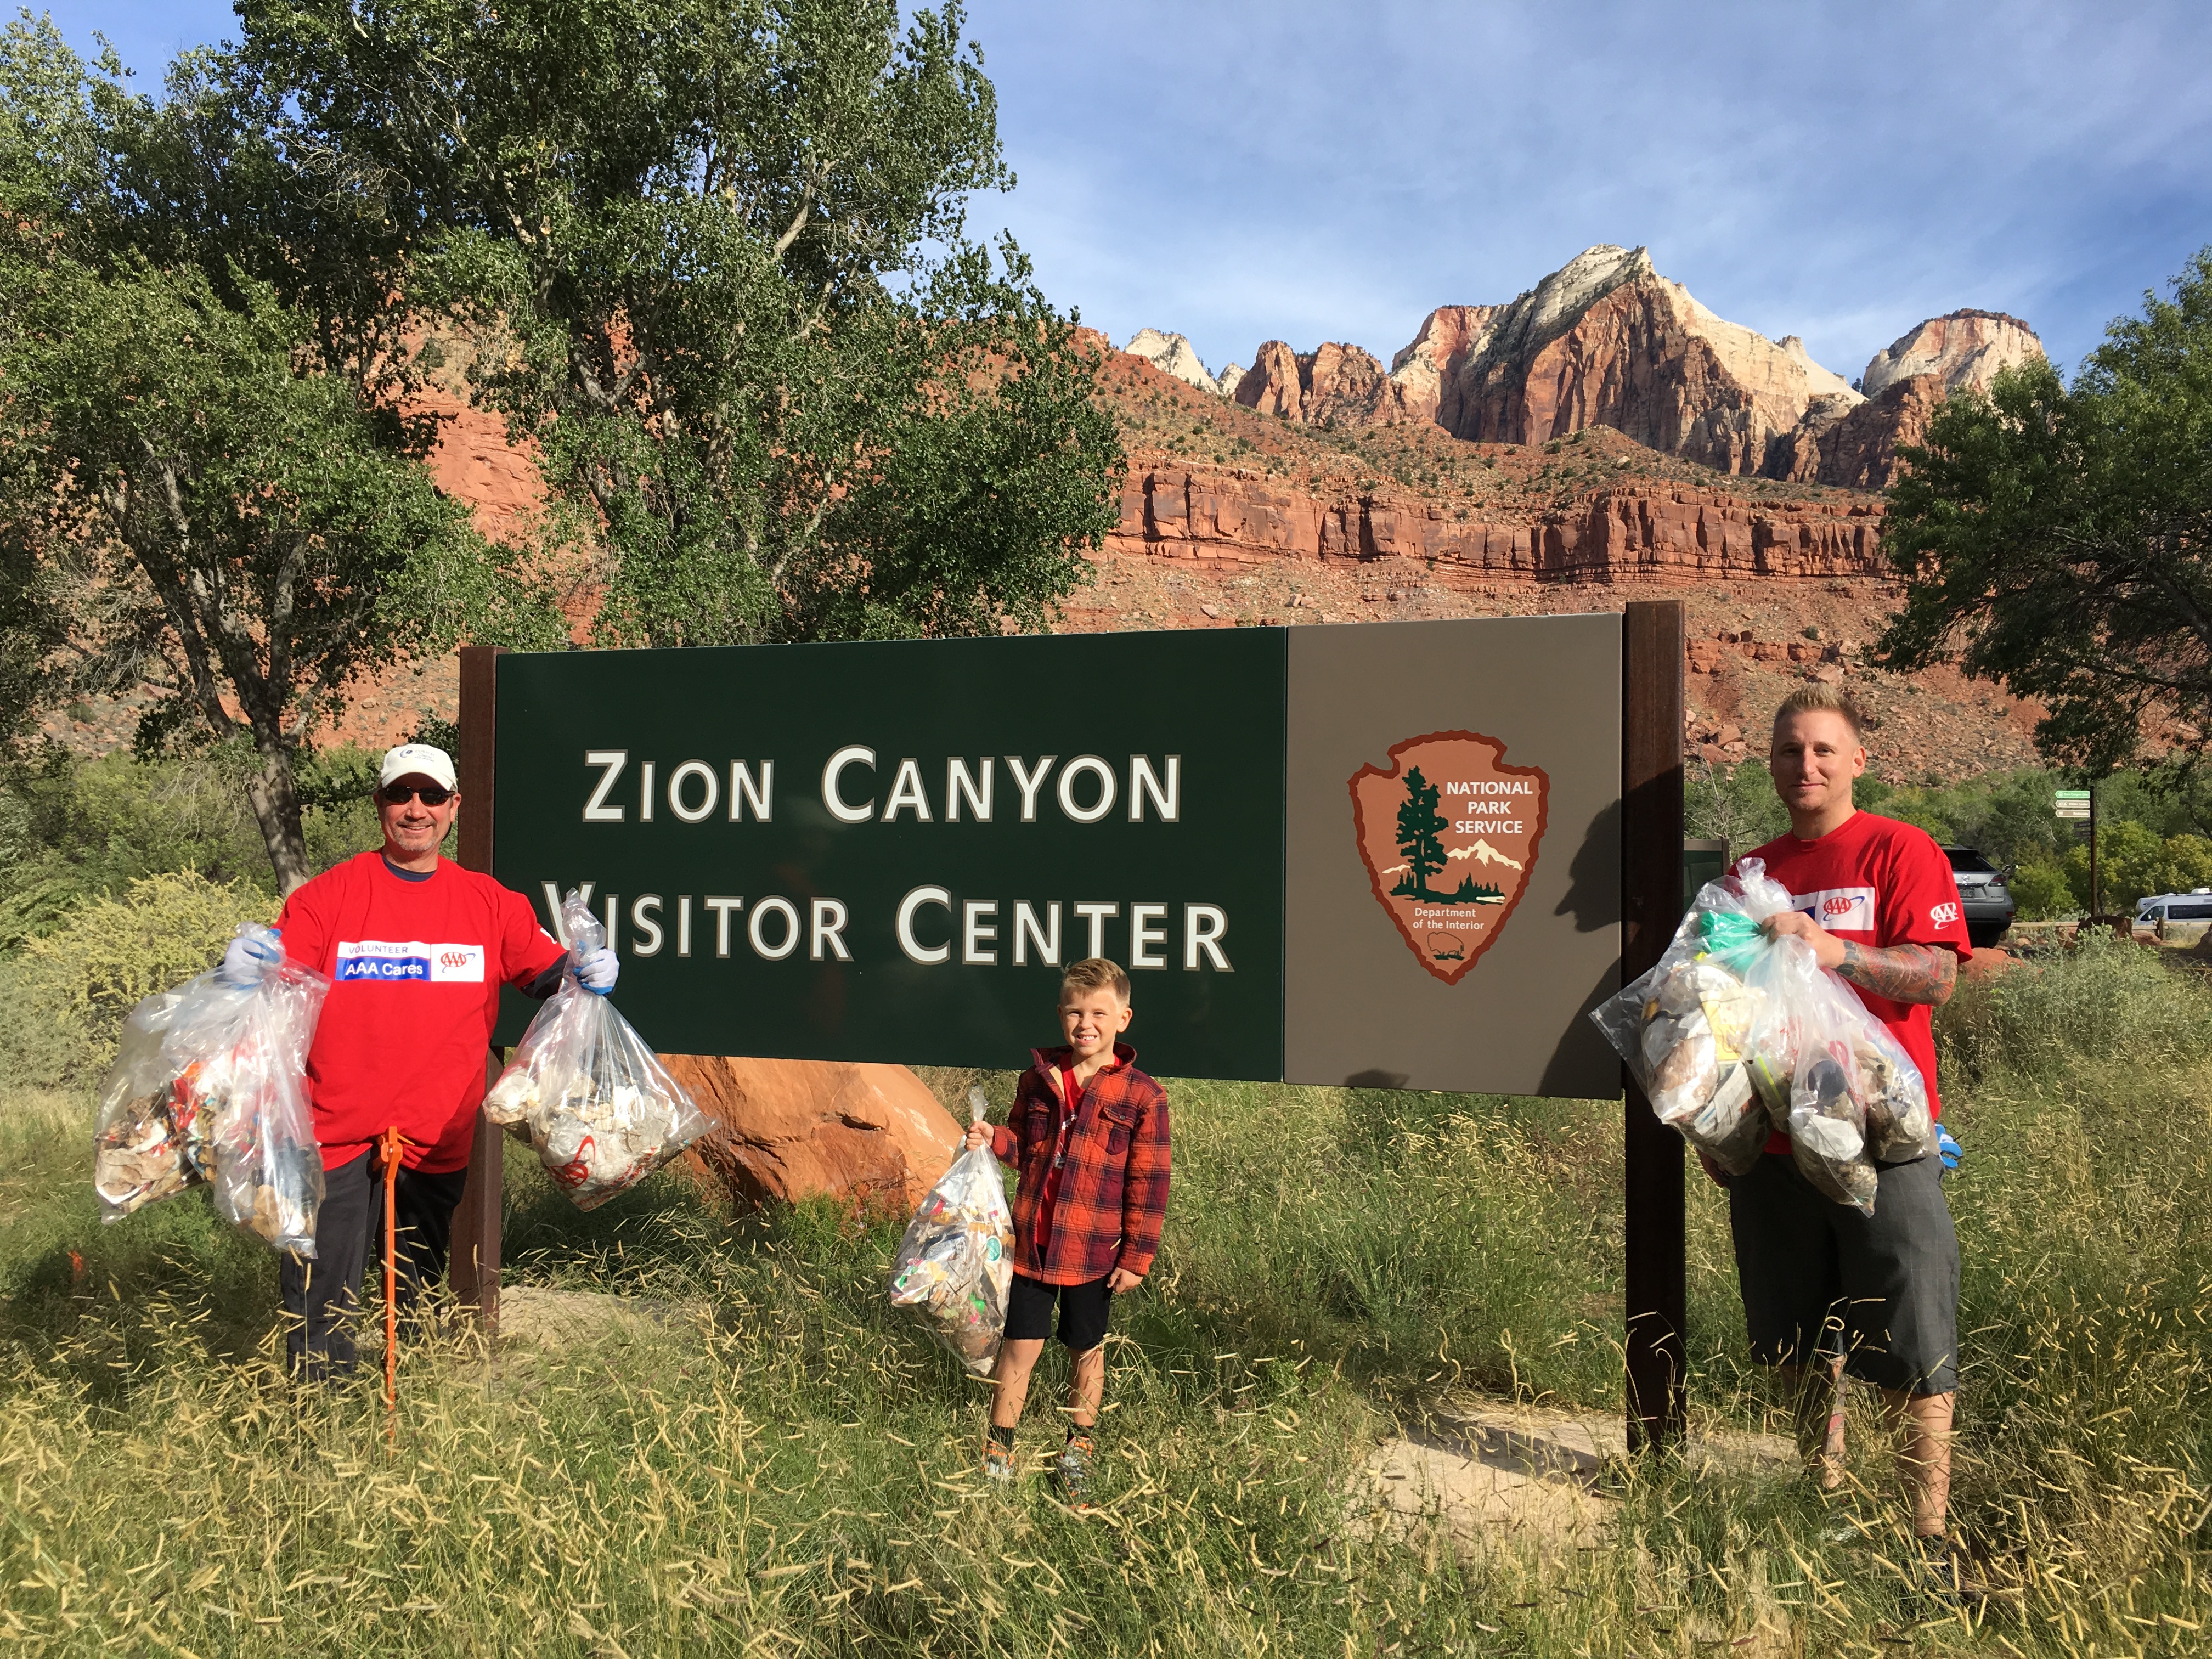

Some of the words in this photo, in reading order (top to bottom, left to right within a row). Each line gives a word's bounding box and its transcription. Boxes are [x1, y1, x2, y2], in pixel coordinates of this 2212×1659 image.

[1447, 781, 1533, 795] NATIONAL
[1468, 801, 1512, 814] PARK
[1455, 820, 1523, 834] SERVICE
[1415, 907, 1476, 919] Department
[1825, 897, 1850, 915] AAA
[1413, 919, 1424, 929] of
[1427, 920, 1443, 929] the
[1446, 921, 1485, 930] Interior
[349, 945, 408, 954] VOLUNTEER
[442, 952, 465, 967] AAA
[345, 962, 379, 976] AAA
[382, 963, 423, 975] Cares
